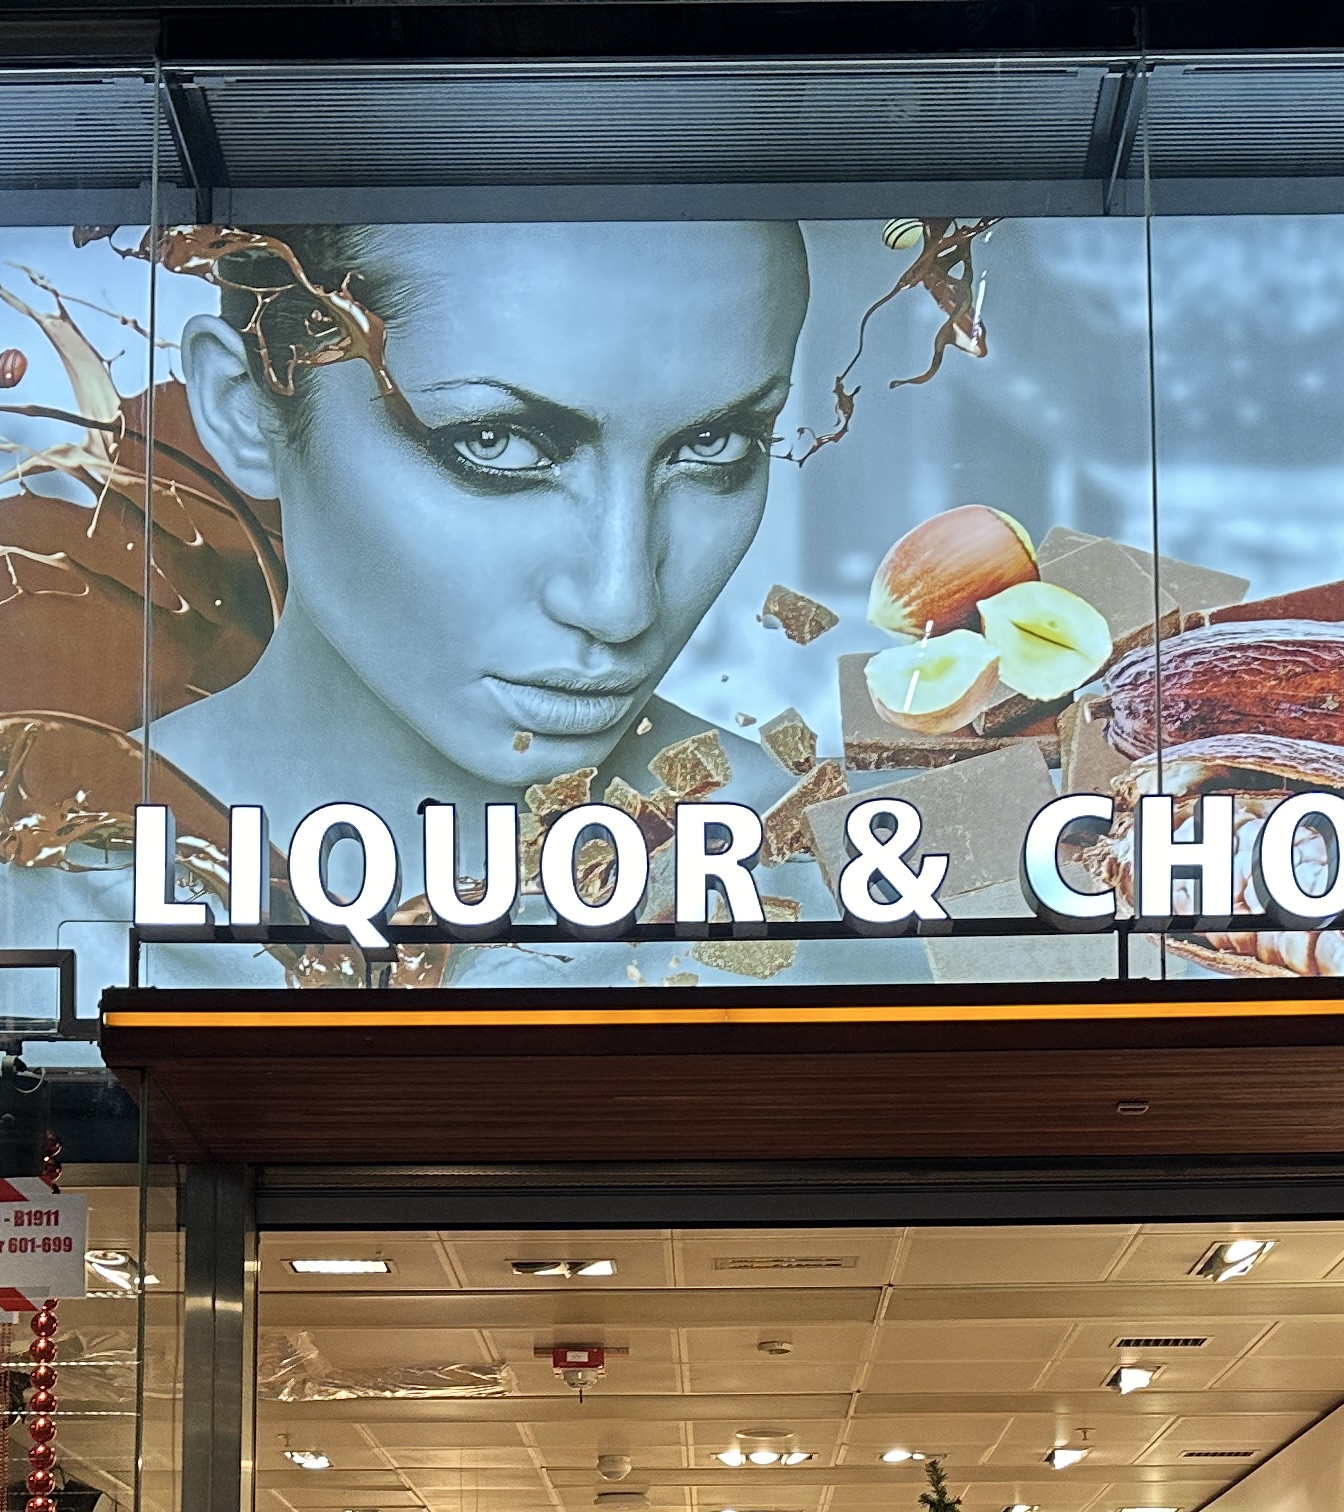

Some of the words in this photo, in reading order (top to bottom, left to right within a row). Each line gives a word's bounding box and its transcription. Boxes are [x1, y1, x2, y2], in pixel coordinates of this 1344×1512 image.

[133, 802, 767, 951] LIQUOR
[836, 799, 951, 925] &
[14, 1209, 59, 1227] B1911
[8, 1236, 73, 1253] 601-699
